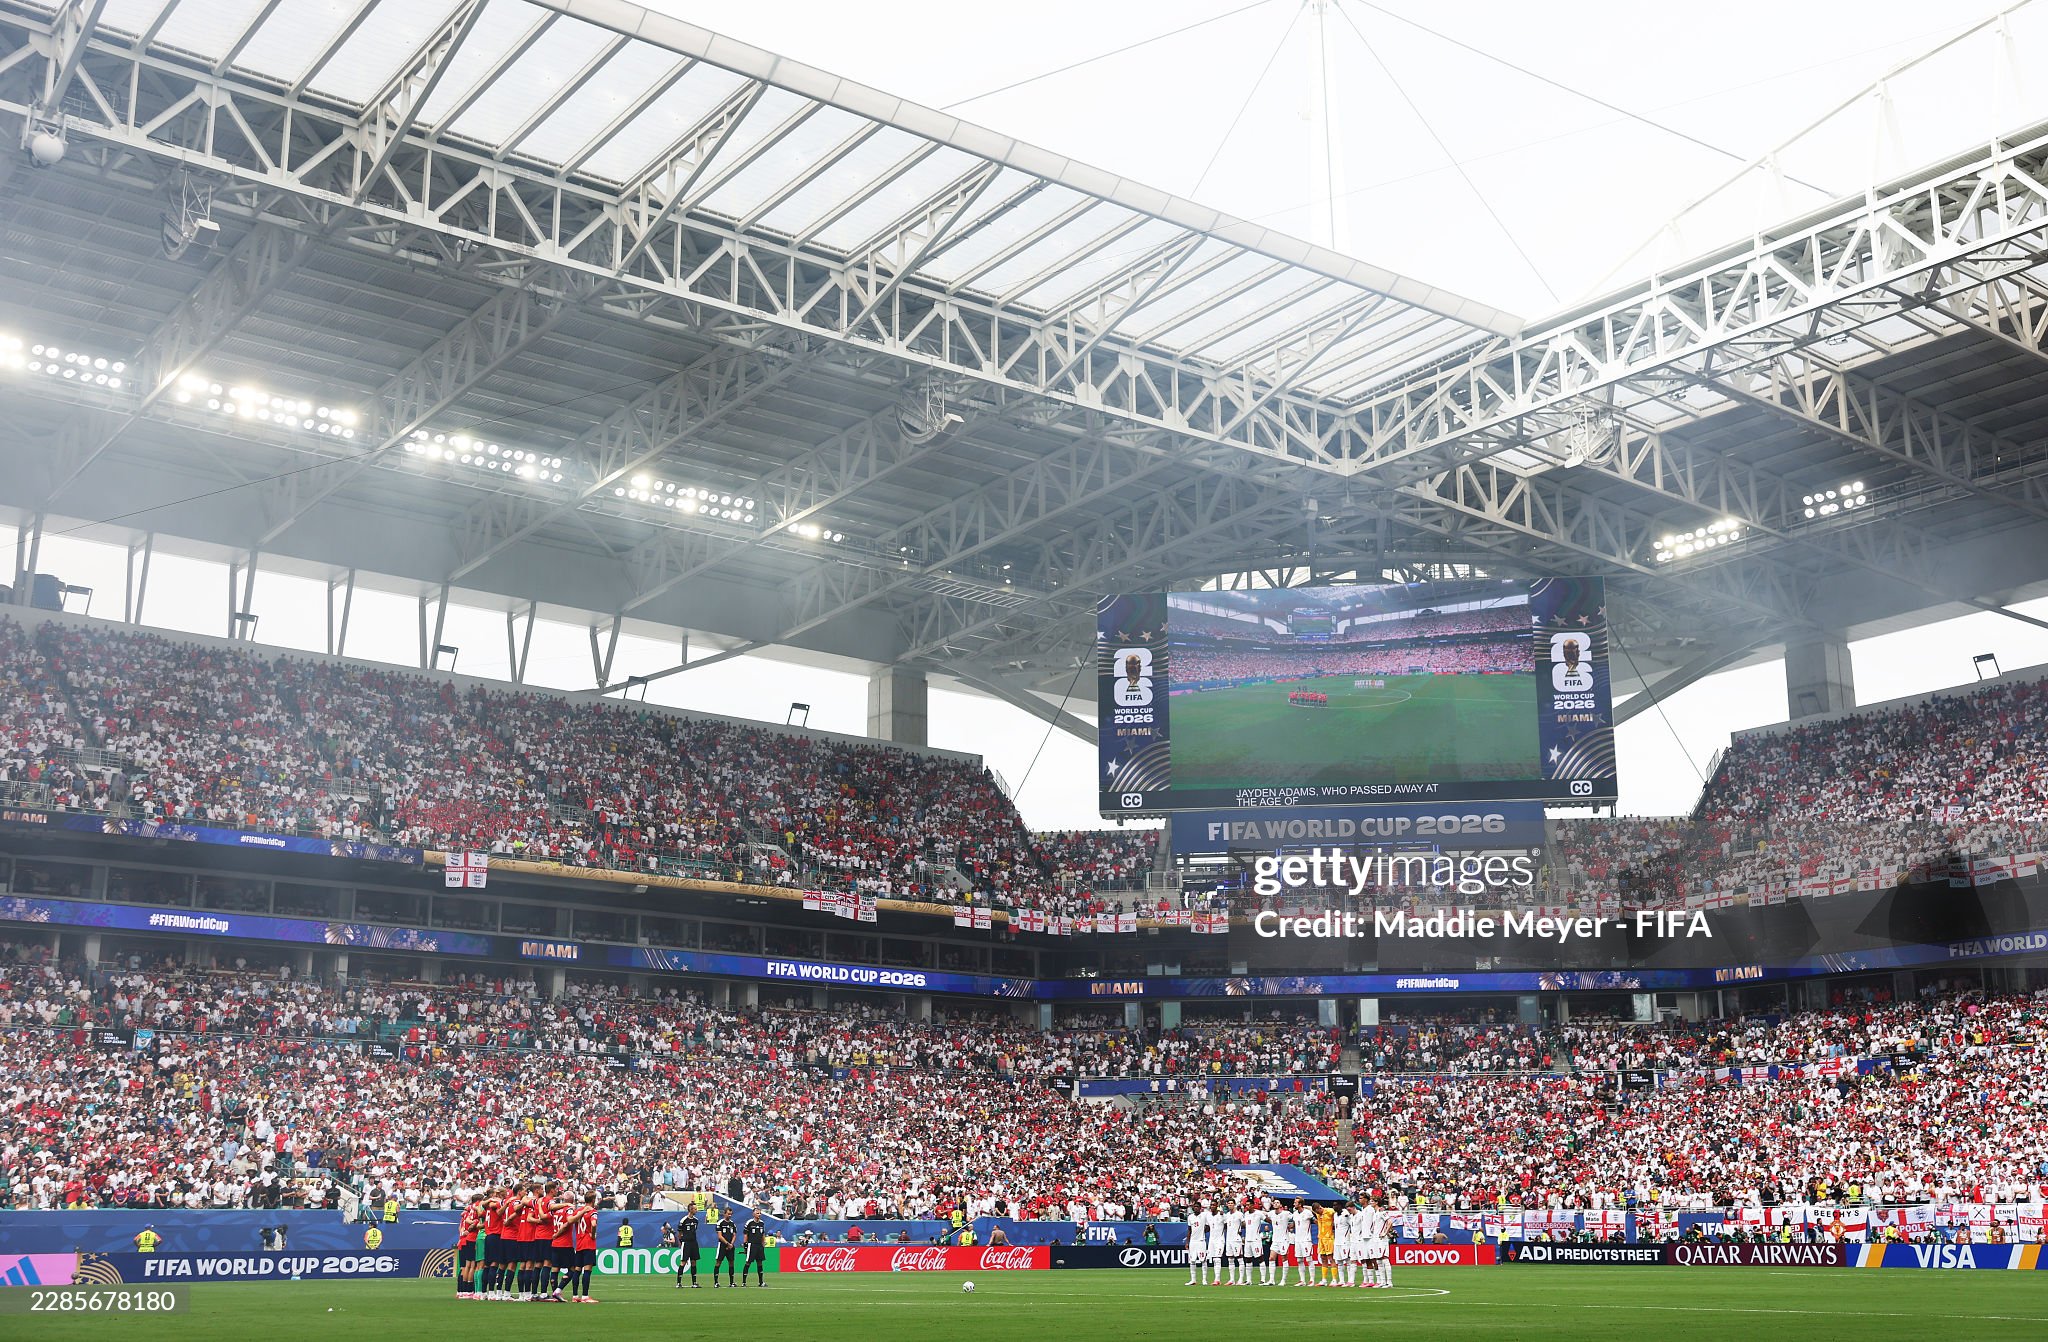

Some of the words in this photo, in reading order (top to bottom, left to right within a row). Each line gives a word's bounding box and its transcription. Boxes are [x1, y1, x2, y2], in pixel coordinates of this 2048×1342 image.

[1554, 699, 1595, 710] 2026
[1114, 714, 1153, 724] 2026
[1557, 713, 1593, 722] MIAMI
[1117, 728, 1151, 737] MIAMI
[1236, 788, 1277, 798] JAYDEN
[1279, 787, 1319, 797] ADAMS,
[1321, 786, 1348, 796] WHO
[1350, 785, 1392, 795] PASSED
[1393, 784, 1424, 794] AWAY
[1425, 783, 1439, 793] AT
[1572, 782, 1590, 794] CC
[1123, 795, 1140, 806] CC
[1236, 797, 1258, 807] THE
[1259, 797, 1281, 806] AGE
[1284, 796, 1299, 806] OF
[3, 810, 48, 824] MIAMI
[1208, 821, 1261, 841] FIFA
[1264, 819, 1356, 840] WORLD
[1360, 817, 1411, 837] CUP
[1415, 814, 1506, 835] 2026
[240, 834, 286, 848] #FIFAWorldCup
[149, 913, 229, 933] #FIFAWorldCup
[522, 941, 578, 959] MIAMI
[1949, 940, 1985, 957] FIFA
[1985, 934, 2047, 953] WORLD
[766, 961, 798, 977] FIFA
[798, 964, 849, 981] WORLD
[850, 968, 879, 982] CUP
[879, 971, 927, 987] 2026
[1715, 965, 1763, 982] MIAMI
[1091, 982, 1144, 995] MIAMI
[1396, 977, 1459, 990] #FIFAWorldCup
[1088, 1227, 1117, 1241] FIFA
[797, 1247, 860, 1272] Coca-Cola
[890, 1247, 950, 1271] Coca-Cola
[979, 1246, 1036, 1271] Coca-Cola
[1395, 1246, 1460, 1264] Lenovo
[1518, 1245, 1552, 1261] ADI
[1555, 1248, 1661, 1261] PREDICTSTREET
[1675, 1245, 1742, 1266] QATAR
[1750, 1245, 1838, 1265] AIRWAYS
[1908, 1244, 1977, 1269] VISA
[144, 1258, 192, 1277] FIFA
[196, 1258, 274, 1275] WORLD
[277, 1257, 320, 1275] CUP
[322, 1256, 394, 1273] 2026
